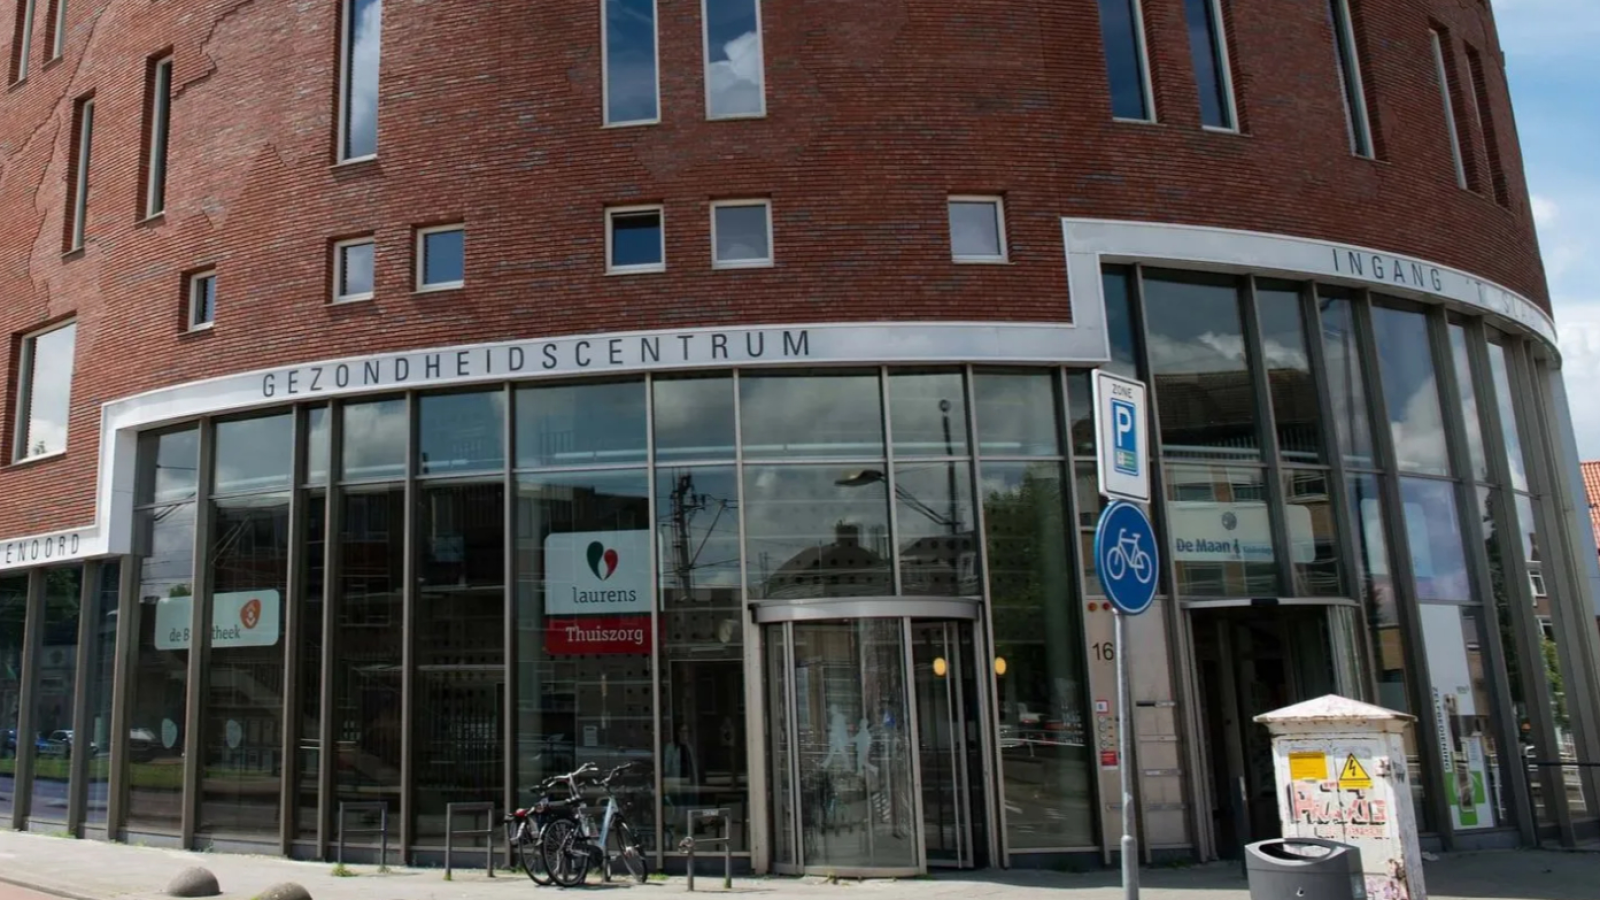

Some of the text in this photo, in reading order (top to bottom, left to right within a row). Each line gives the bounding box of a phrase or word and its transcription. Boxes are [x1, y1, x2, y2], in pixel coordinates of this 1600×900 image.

[1332, 248, 1442, 292] INGANG
[262, 330, 810, 398] GEZONDHEIDSCENTRUM
[1111, 383, 1133, 399] ZONE
[1115, 405, 1132, 447] P
[1176, 538, 1192, 553] De
[1196, 538, 1231, 553] Maan
[572, 586, 637, 604] laurens
[169, 628, 182, 642] de
[565, 625, 644, 645] Thuiszorg
[1092, 642, 1114, 661] 16
